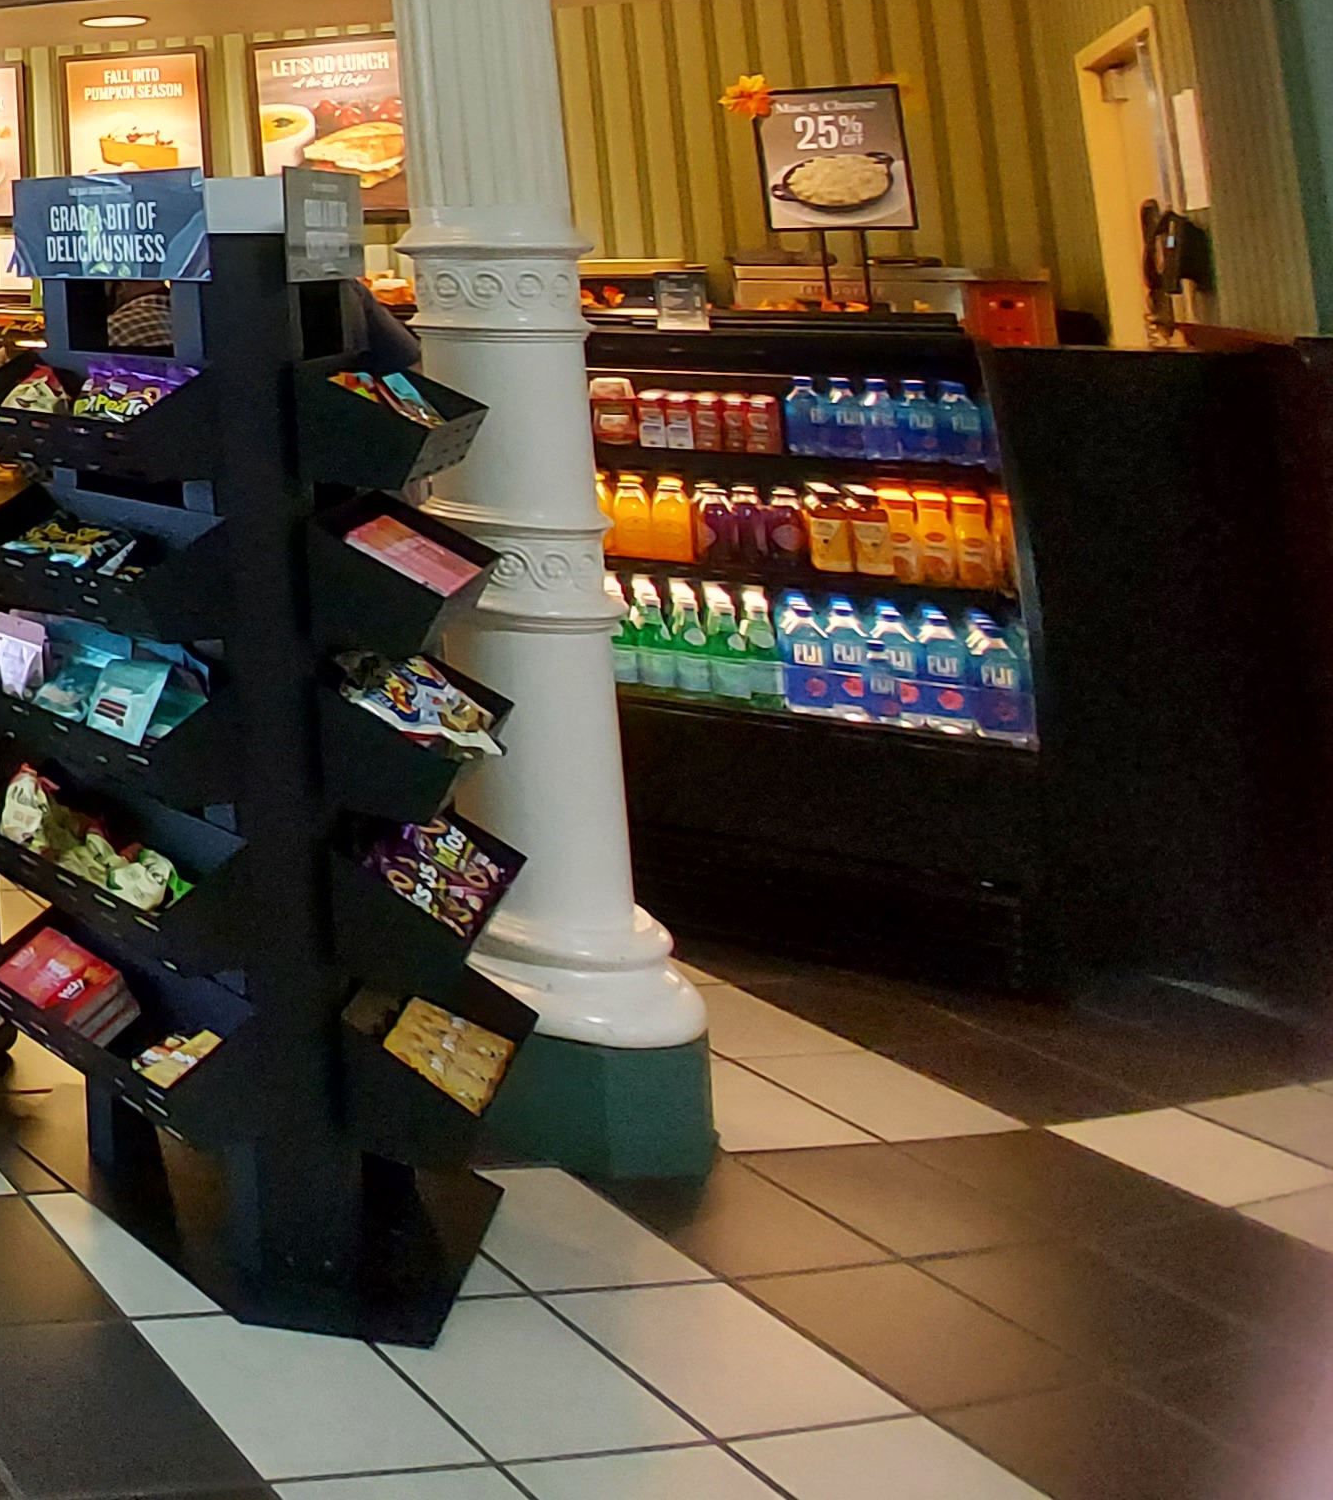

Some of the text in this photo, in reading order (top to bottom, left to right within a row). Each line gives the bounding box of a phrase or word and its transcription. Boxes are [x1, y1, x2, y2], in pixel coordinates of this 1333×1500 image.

[103, 67, 159, 85] FALL INTO
[271, 51, 390, 77] LET'S DO LUNCH
[84, 83, 183, 101] PUMPKIN SEASON
[794, 114, 864, 150] 25% OFF
[49, 201, 157, 233] GRAB A BIT OF
[46, 233, 166, 263] DELICIOUSNESS
[793, 643, 823, 667] FIJI
[833, 643, 862, 665] FIJI
[927, 654, 959, 678] FIJI
[982, 665, 1015, 689] FIJI
